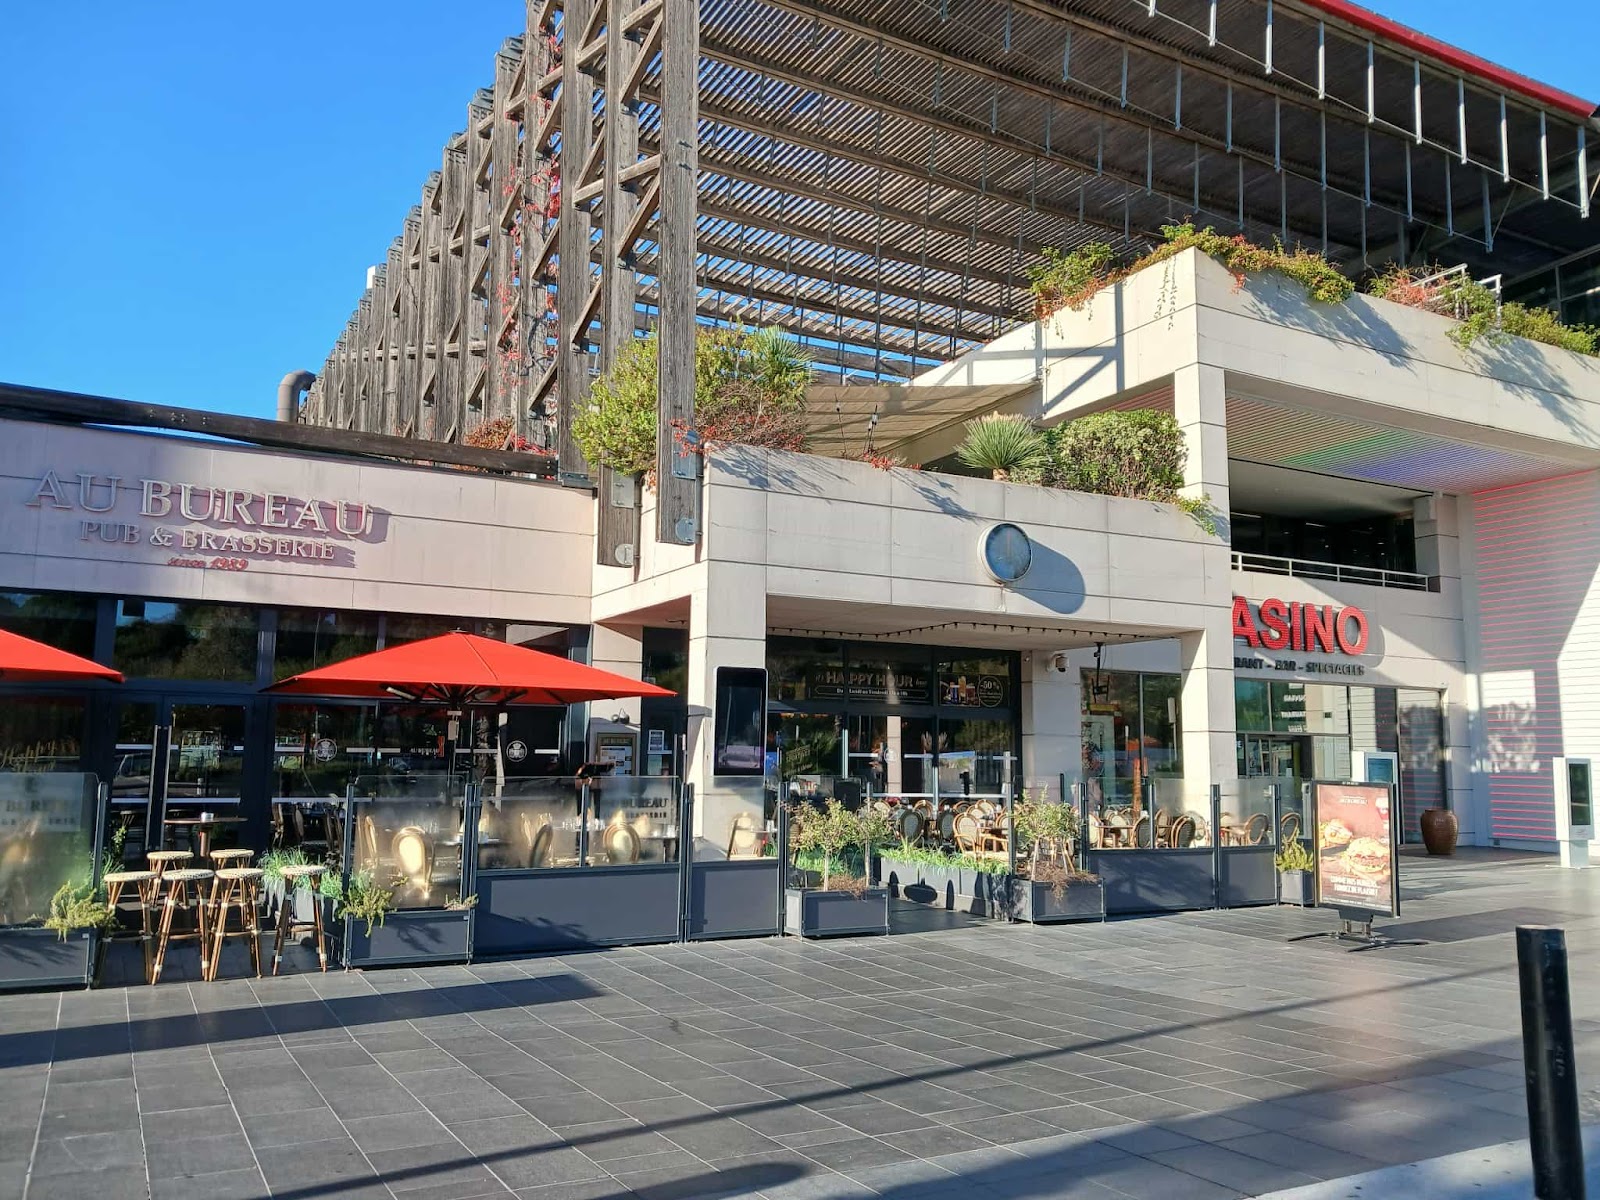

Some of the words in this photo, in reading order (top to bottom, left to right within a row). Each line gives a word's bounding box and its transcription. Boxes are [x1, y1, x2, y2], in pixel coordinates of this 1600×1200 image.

[25, 469, 122, 512] AU
[139, 479, 373, 536] BUREAU
[80, 520, 141, 545] PUB
[149, 526, 173, 548] &
[181, 529, 336, 560] BRASSERIE
[826, 670, 873, 685] HAPPY
[1274, 659, 1297, 672] BAR
[1306, 661, 1366, 676] SPECTACLES
